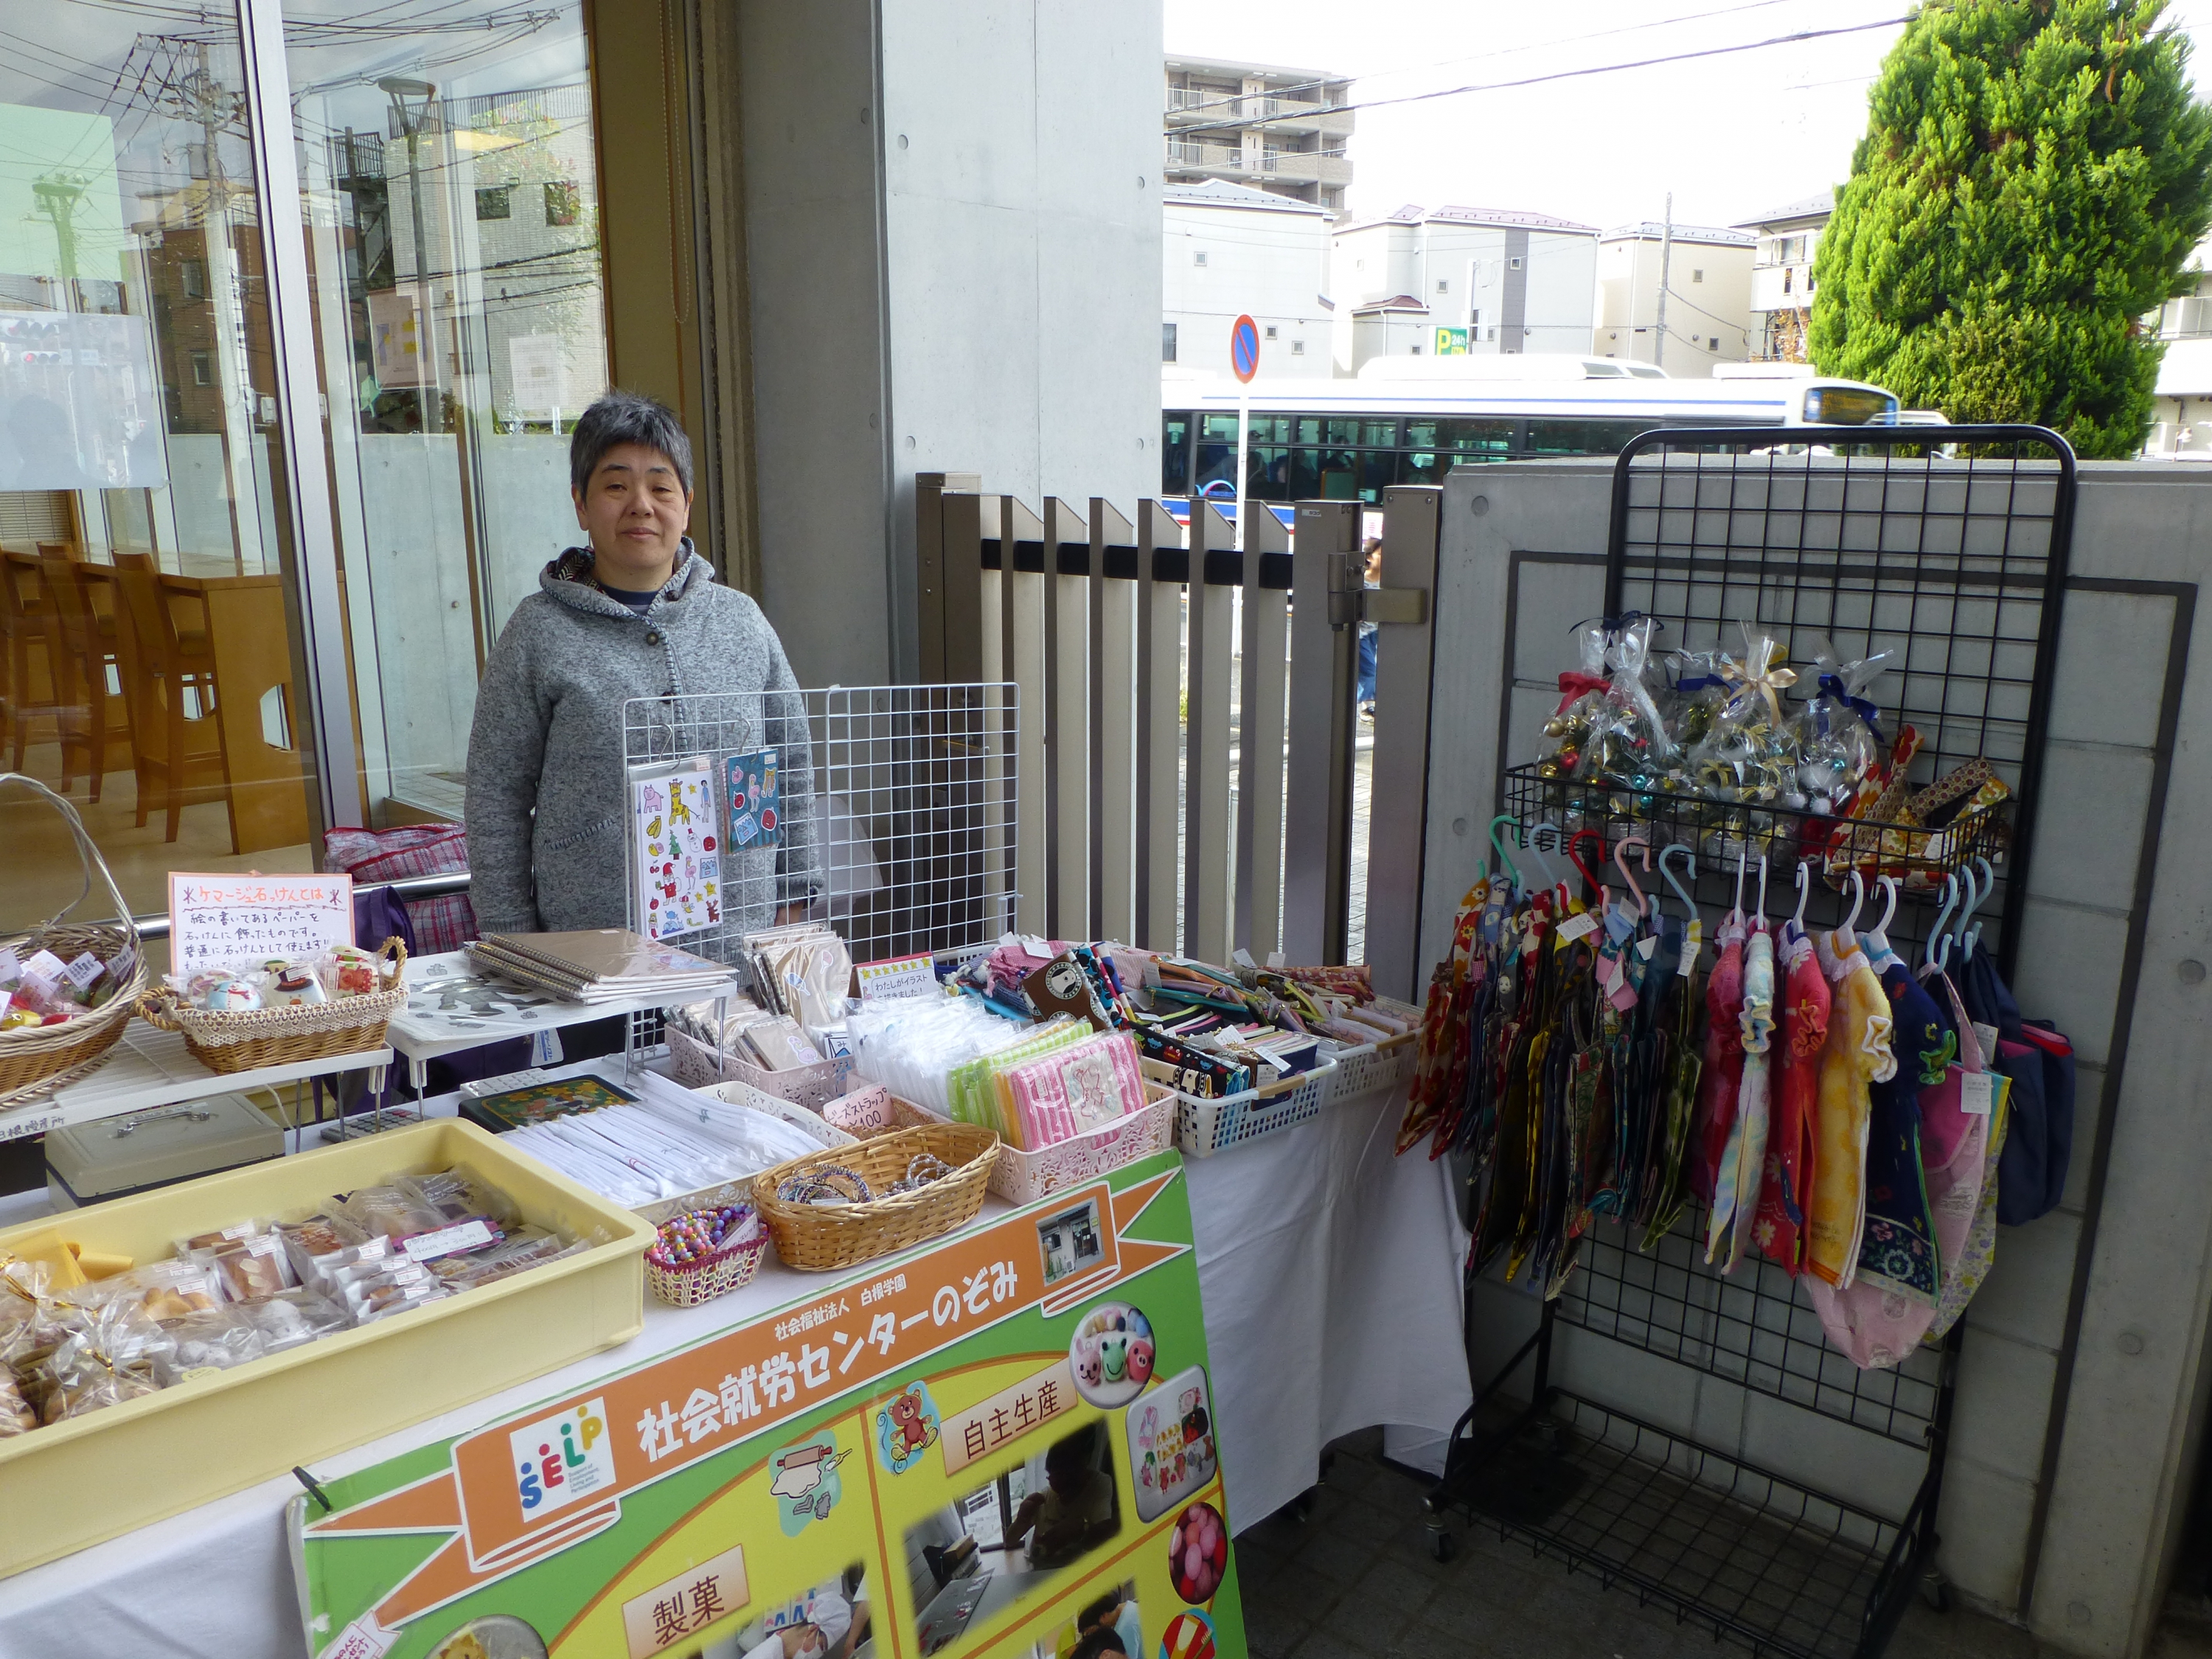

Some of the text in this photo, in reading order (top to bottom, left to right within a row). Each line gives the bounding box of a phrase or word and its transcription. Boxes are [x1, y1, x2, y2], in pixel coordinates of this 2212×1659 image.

[1437, 329, 1466, 355] P 24h
[875, 974, 928, 992] わたしがイラスト
[827, 1087, 888, 1124] ビーズストラップ
[774, 1273, 907, 1341] 社会福祉法人 白根学園
[637, 1260, 1018, 1462] 社会就労センターのぞみ
[963, 1380, 1062, 1461] 自主生産
[652, 1574, 726, 1646] 製菓
